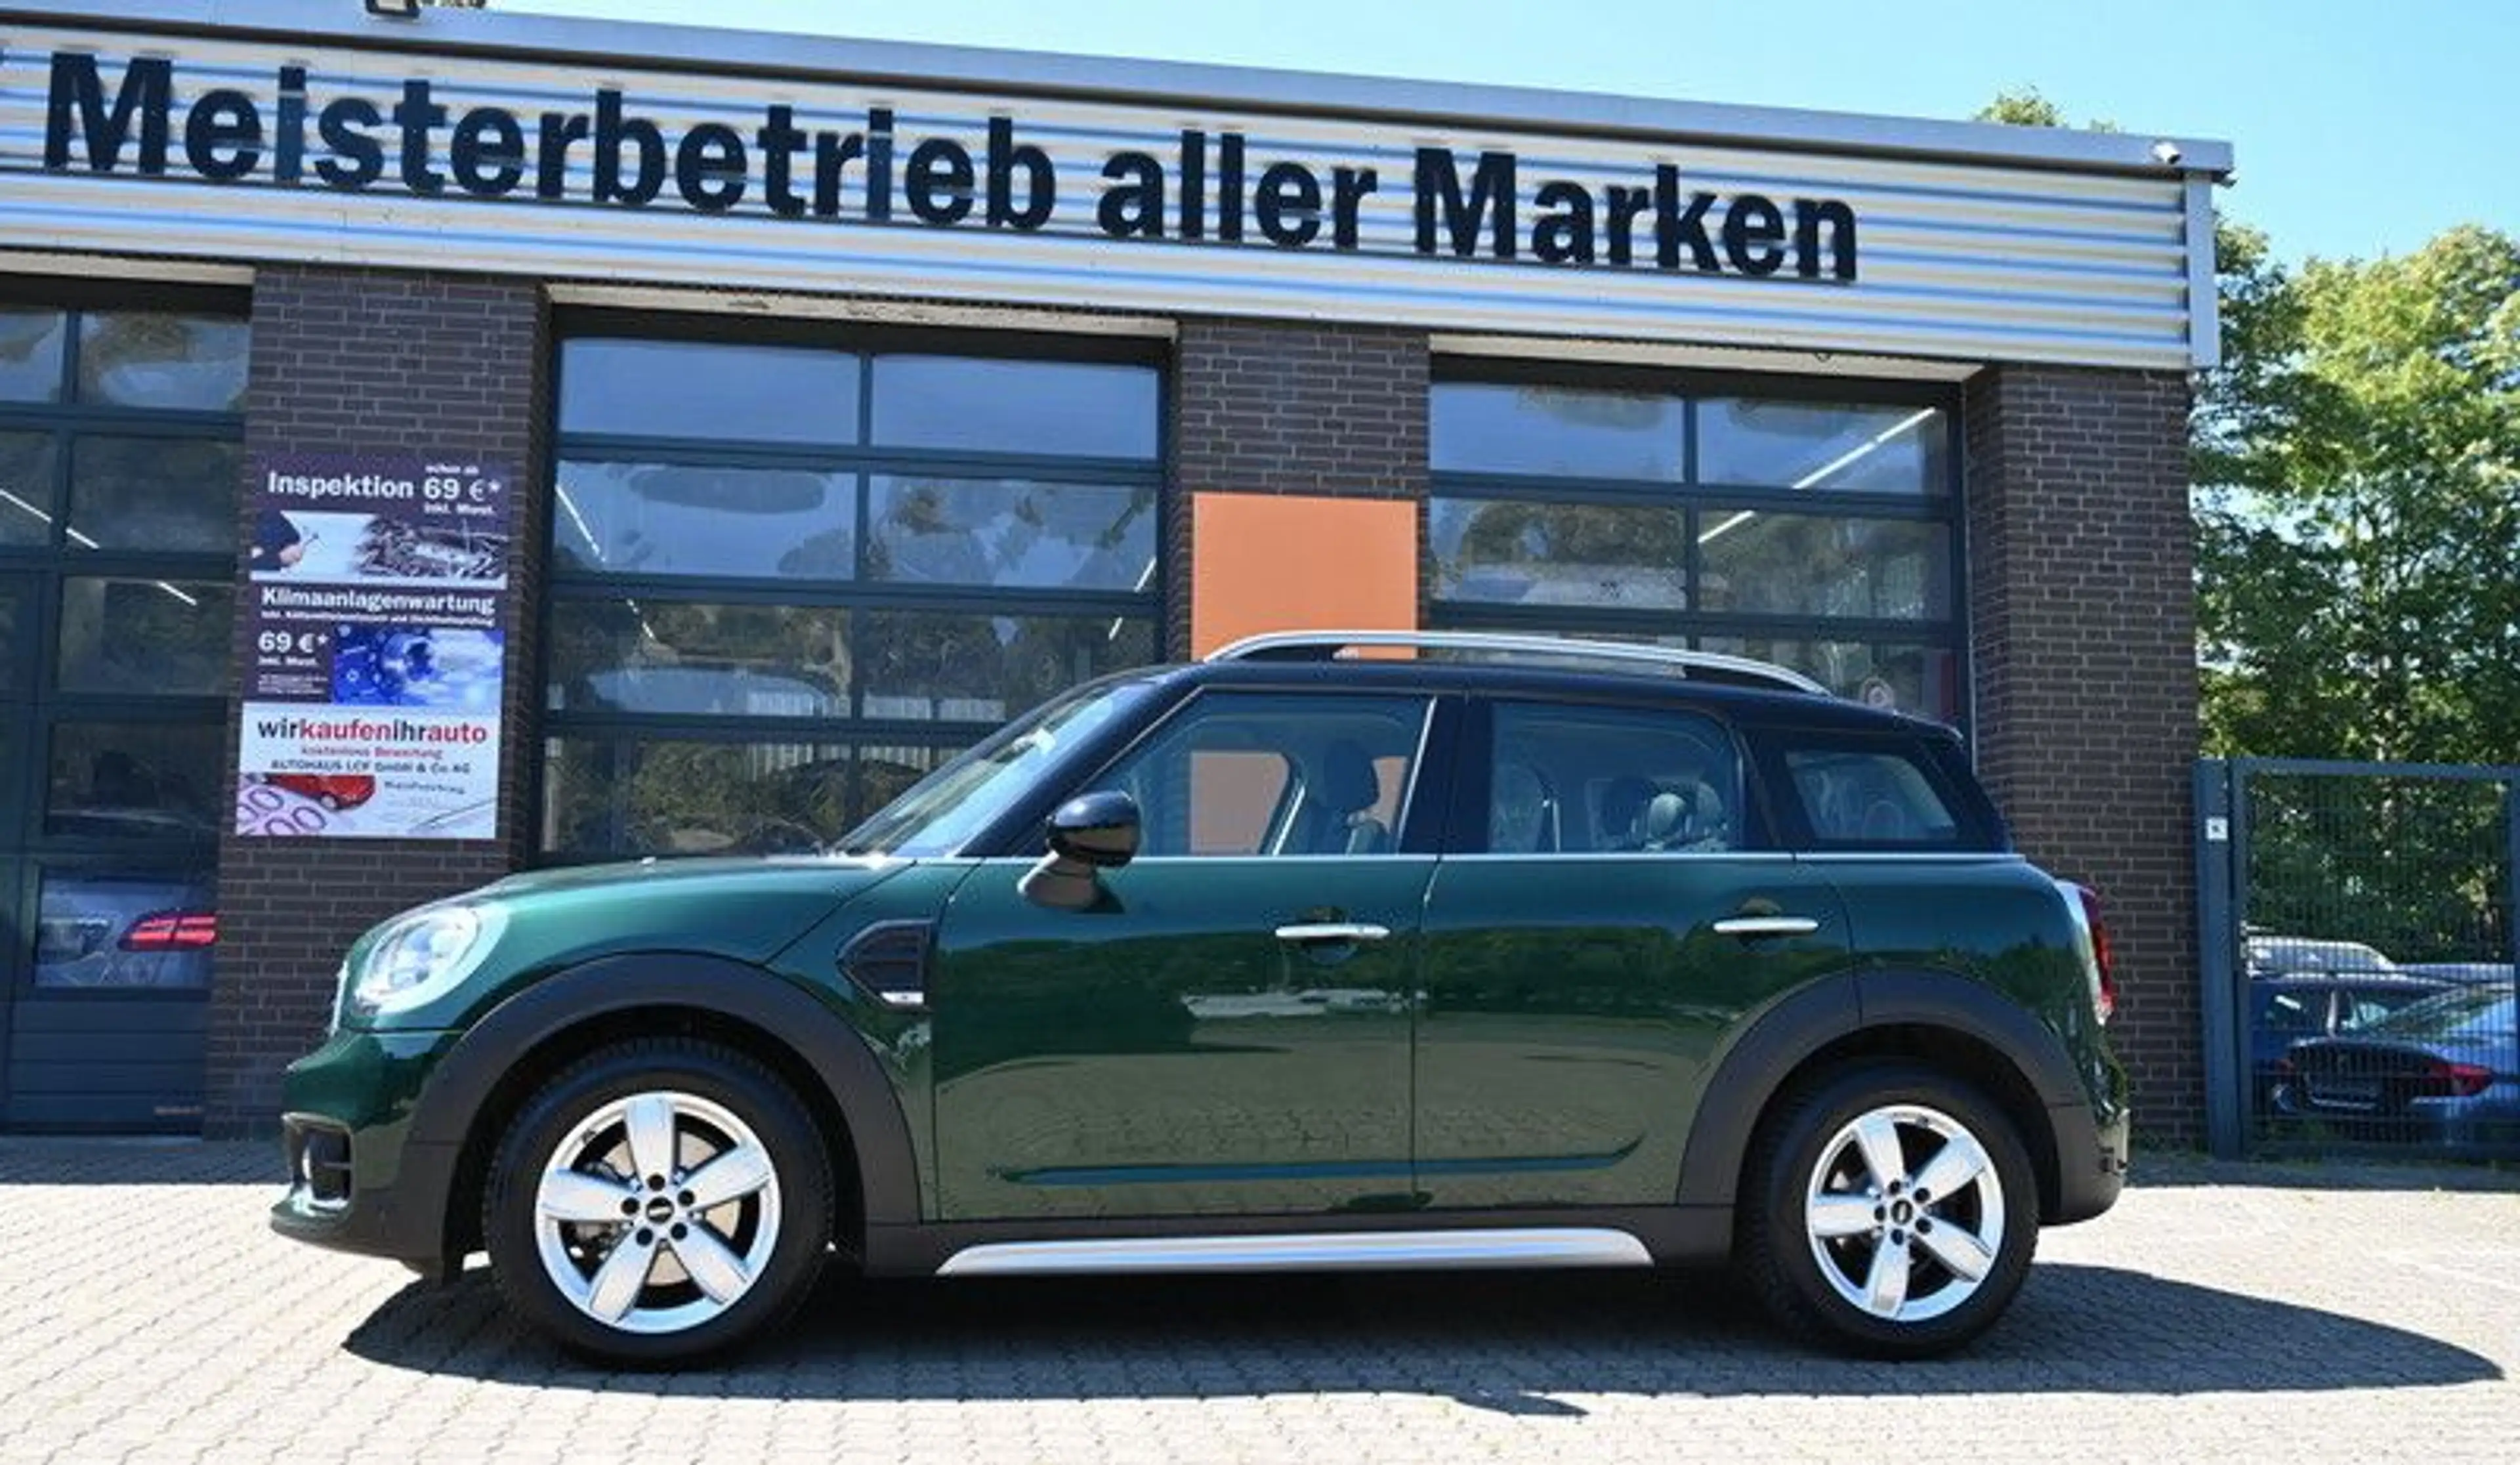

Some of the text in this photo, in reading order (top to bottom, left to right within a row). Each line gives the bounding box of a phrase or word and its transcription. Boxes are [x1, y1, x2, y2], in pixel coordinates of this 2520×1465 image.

[44, 53, 1857, 284] Meisterbetrieb aller Marken
[268, 471, 414, 499] Inspektion
[425, 478, 459, 501] 69
[262, 586, 496, 615] Klimaanlagenwartung
[258, 630, 291, 653] 69
